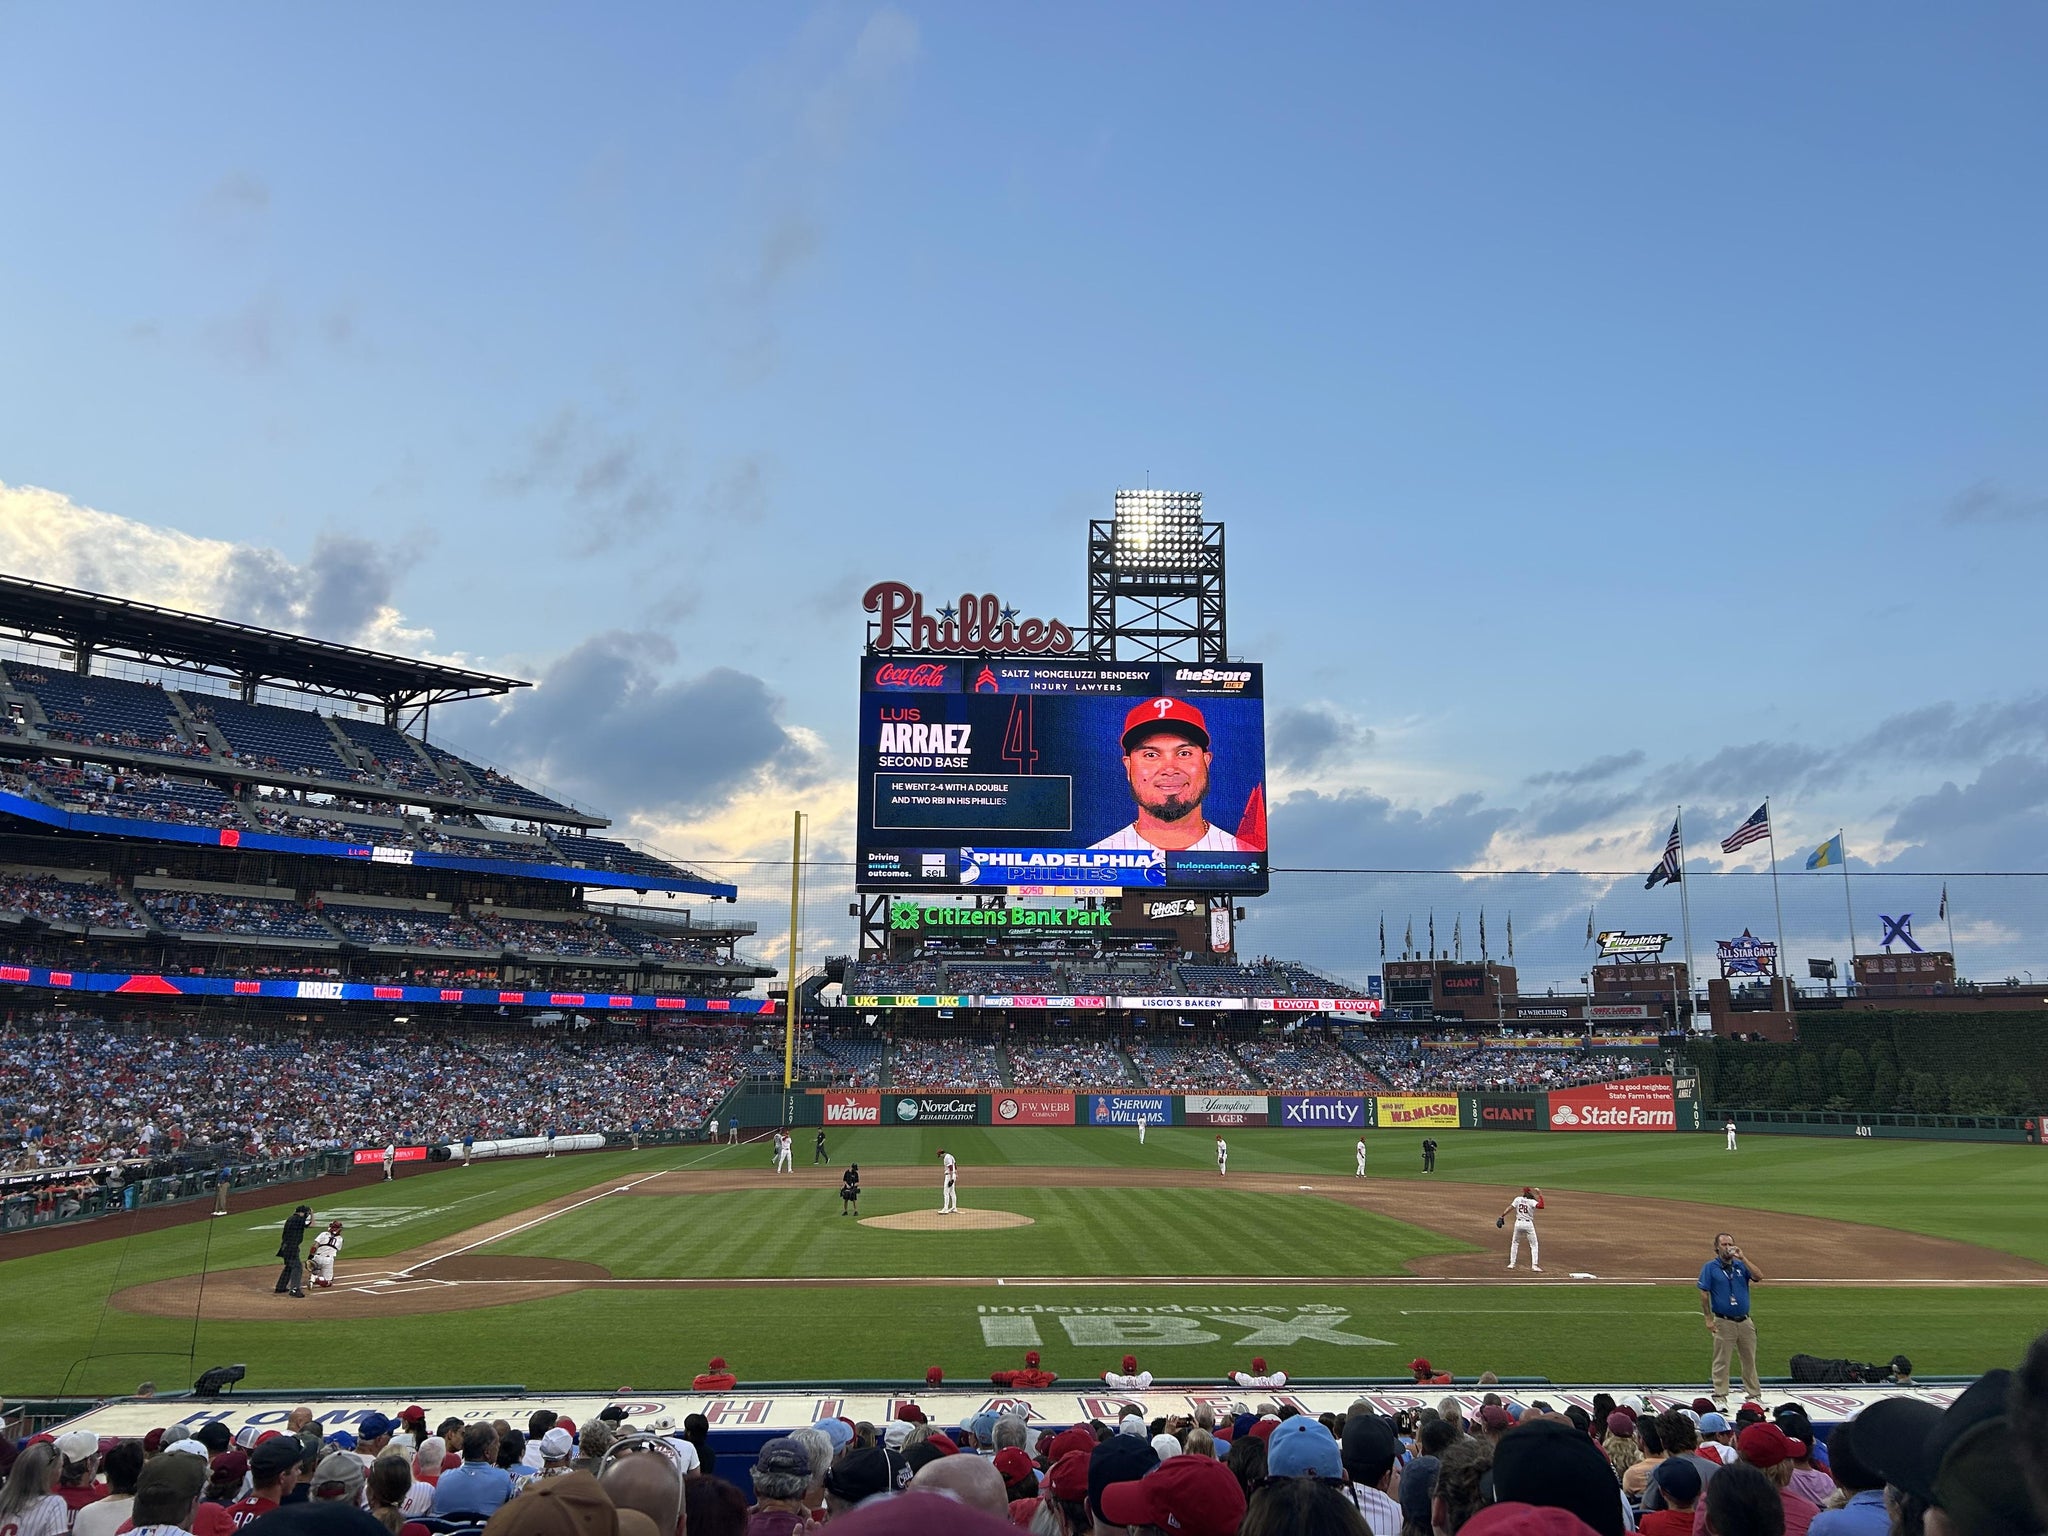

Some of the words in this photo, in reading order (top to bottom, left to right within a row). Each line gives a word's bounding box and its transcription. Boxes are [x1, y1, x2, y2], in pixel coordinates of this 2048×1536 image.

[863, 581, 1073, 653] Phillies
[875, 662, 948, 687] Coca-Cola
[1001, 669, 1029, 678] SALTZ
[1034, 670, 1096, 679] MONGELUZZI
[1100, 671, 1150, 680] BENDESKY
[1175, 668, 1252, 682] theScore
[1030, 682, 1068, 691] INJURY
[1075, 683, 1122, 692] LAWYERS
[880, 707, 921, 721] LUIS
[879, 723, 971, 754] ARRAEZ
[1002, 694, 1038, 775] 4
[879, 756, 932, 767] SECOND
[935, 757, 969, 768] BASE
[891, 783, 904, 791] HE
[905, 783, 929, 791] WENT
[930, 783, 944, 791] 2-4
[945, 783, 967, 791] WITH
[975, 784, 1009, 792] DOUBLE
[891, 796, 910, 804] AND
[911, 796, 931, 804] TWO
[932, 797, 946, 805] RBI
[946, 797, 955, 805] IN
[956, 797, 971, 805] HIS
[971, 797, 1007, 805] PHILLIES
[868, 853, 900, 863] Driving
[972, 852, 1151, 867] PHILADELPHIA
[868, 869, 912, 877] outcomes.
[1176, 862, 1247, 873] Independence
[1008, 866, 1118, 881] PHILLIES
[1150, 898, 1187, 920] GHOST
[924, 906, 1007, 926] Citizens
[1011, 906, 1064, 926] Bank
[1066, 906, 1112, 926] Park
[1603, 932, 1664, 948] Fitzpatrick
[1717, 948, 1733, 958] ALL
[1733, 948, 1753, 958] STAR
[1754, 947, 1776, 957] GAME
[234, 981, 261, 993] BOHM
[1445, 978, 1480, 988] GIANT
[297, 981, 344, 999] ARRAEZ
[373, 987, 403, 999] TURNER
[440, 990, 463, 1001] STOTT
[855, 996, 878, 1006] UKG
[895, 996, 918, 1006] UKG
[936, 996, 959, 1006] UKG
[1017, 997, 1044, 1006] NECA
[1078, 998, 1105, 1007] NECA
[1142, 999, 1182, 1007] LISCIO'S
[1185, 999, 1222, 1007] BAKERY
[1277, 1000, 1316, 1009] TOYOTA
[1338, 1000, 1377, 1009] TOYOTA
[1625, 1084, 1641, 1092] good
[919, 1100, 976, 1113] NovaCare
[1022, 1102, 1038, 1111] F.W.
[1041, 1102, 1070, 1111] WEBB
[1111, 1097, 1162, 1110] SHERWIN
[1200, 1097, 1251, 1112] Yuengling
[827, 1104, 878, 1120] Wawa
[1286, 1098, 1360, 1122] xfinity
[1482, 1107, 1535, 1121] GIANT
[1210, 1114, 1243, 1123] LAGER
[1856, 1126, 1872, 1136] 401
[1518, 1203, 1529, 1214] 28
[977, 1304, 1290, 1315] Independence
[980, 1315, 1400, 1346] IBX
[179, 1408, 431, 1427] HOM
[464, 1410, 498, 1418] OF
